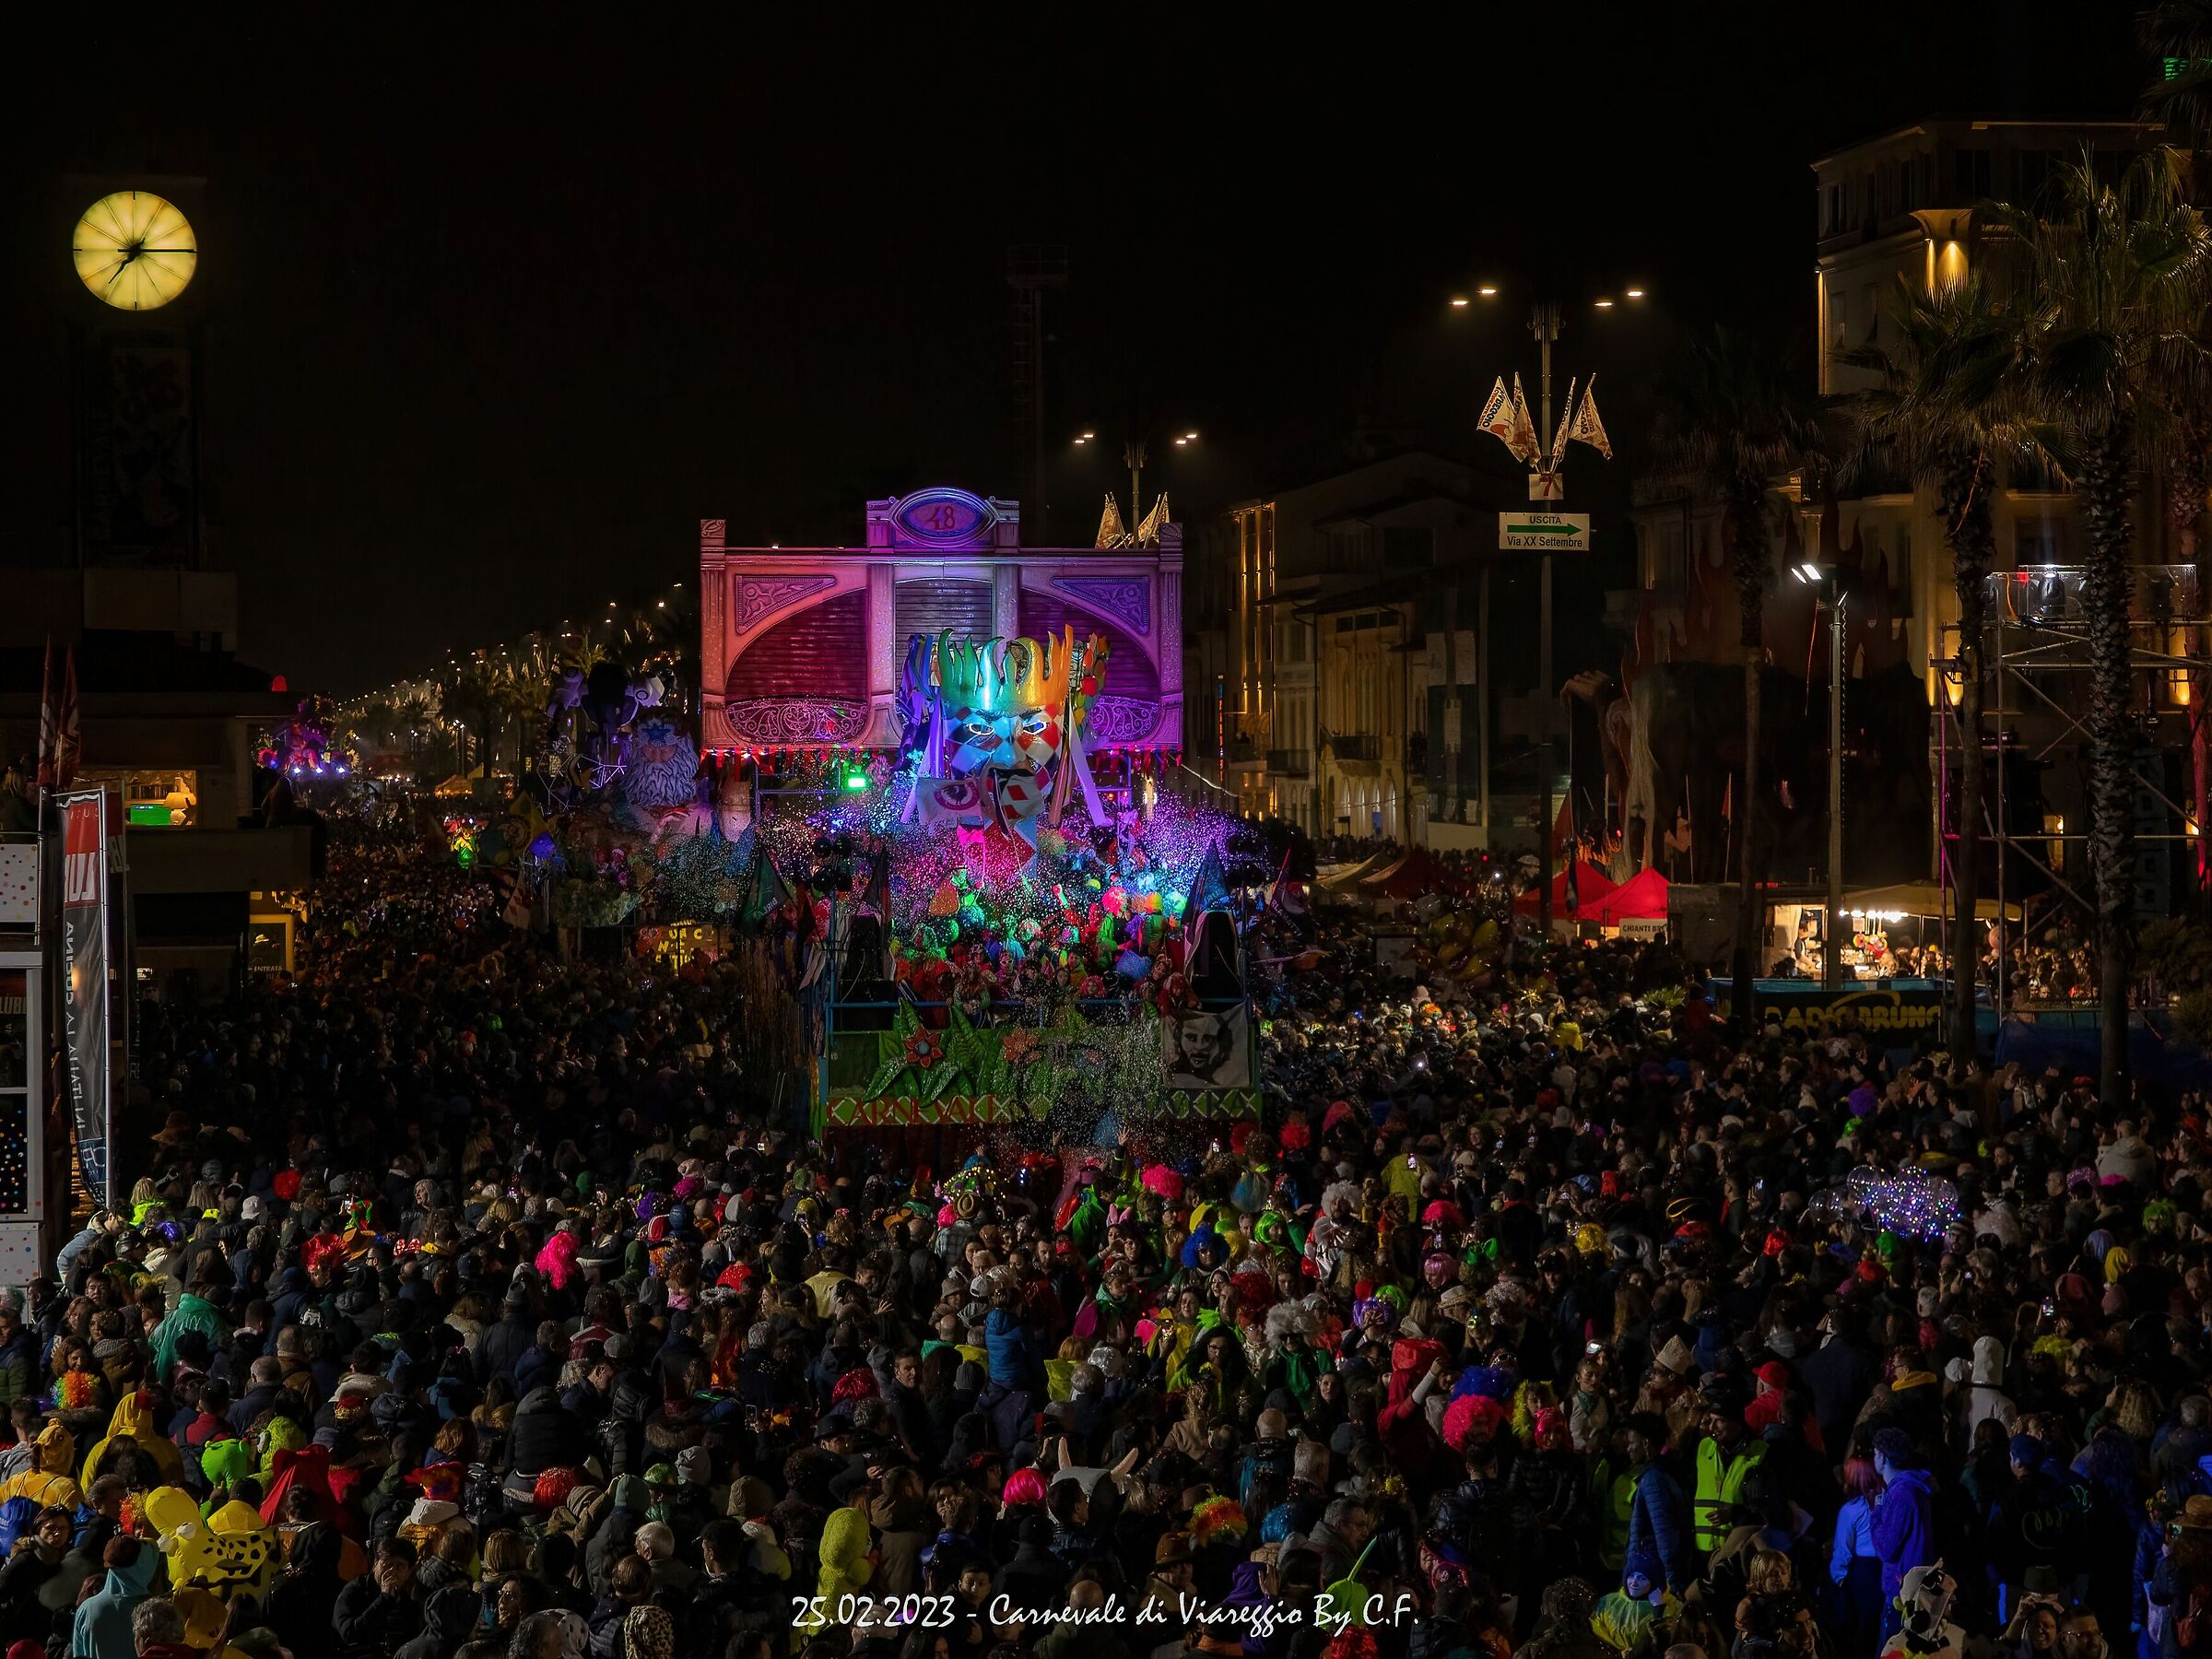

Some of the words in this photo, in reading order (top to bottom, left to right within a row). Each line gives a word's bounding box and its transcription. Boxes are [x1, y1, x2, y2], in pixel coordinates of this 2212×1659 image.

[1529, 516, 1561, 524] USCITA
[1507, 535, 1521, 546] Via
[1524, 535, 1536, 547] XX
[1539, 535, 1583, 547] Settembre
